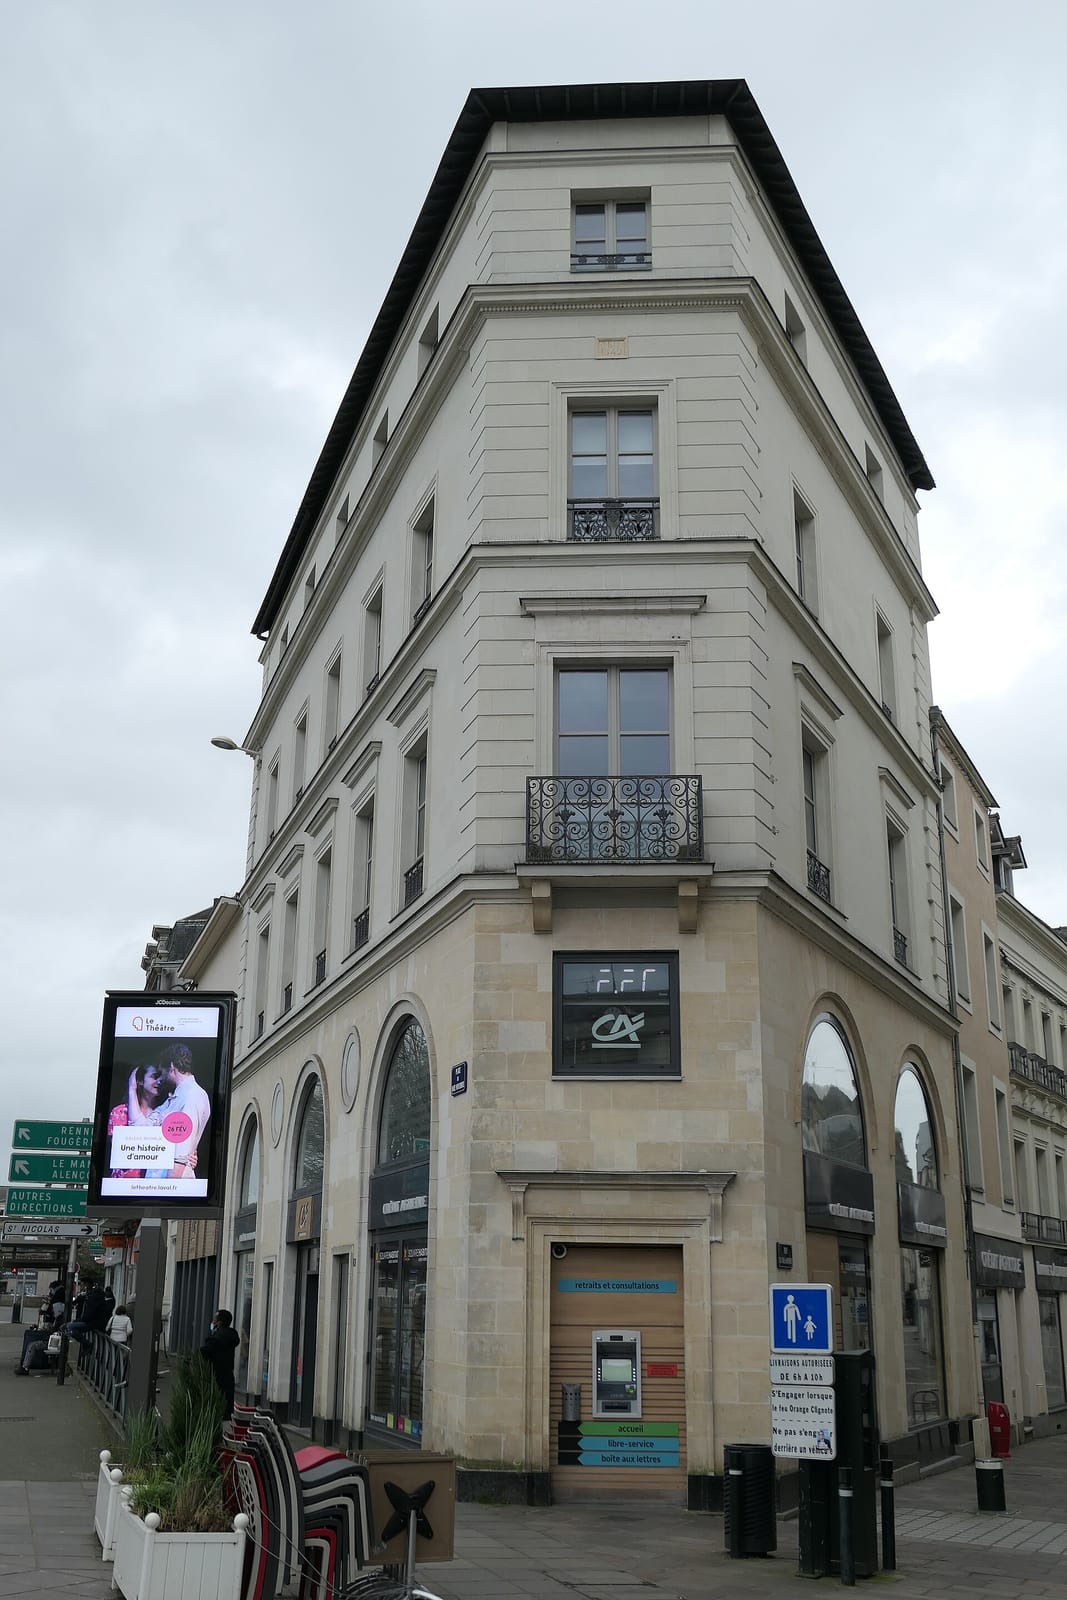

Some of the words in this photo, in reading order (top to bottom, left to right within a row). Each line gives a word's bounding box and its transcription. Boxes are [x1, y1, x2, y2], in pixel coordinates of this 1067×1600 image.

[146, 1024, 175, 1032] Théâtre
[61, 1126, 93, 1136] RENN
[47, 1136, 92, 1146] FOUGÈR
[137, 1144, 166, 1152] histoire
[52, 1159, 65, 1168] LE
[11, 1191, 51, 1201] AUTRES
[10, 1202, 73, 1213] DIRECTIONS
[20, 1225, 60, 1233] NICOLAS
[575, 1281, 602, 1289] retraits
[611, 1281, 660, 1290] consultations
[770, 1359, 800, 1367] LIVRAISONS
[780, 1373, 790, 1381] DE
[793, 1373, 802, 1381] 6h
[804, 1373, 809, 1381] A
[811, 1373, 823, 1381] 10h
[771, 1391, 805, 1400] S'Engager
[807, 1392, 833, 1401] lorsque
[772, 1404, 778, 1412] le
[779, 1404, 788, 1412] feu
[789, 1404, 809, 1414] Orange
[810, 1406, 833, 1415] Clignote
[618, 1424, 644, 1433] accueil
[772, 1427, 782, 1435] Ne
[784, 1428, 797, 1437] pas
[608, 1439, 655, 1449] libre-service
[774, 1443, 798, 1453] derrière
[799, 1445, 807, 1453] un
[636, 1455, 661, 1464] lettres
